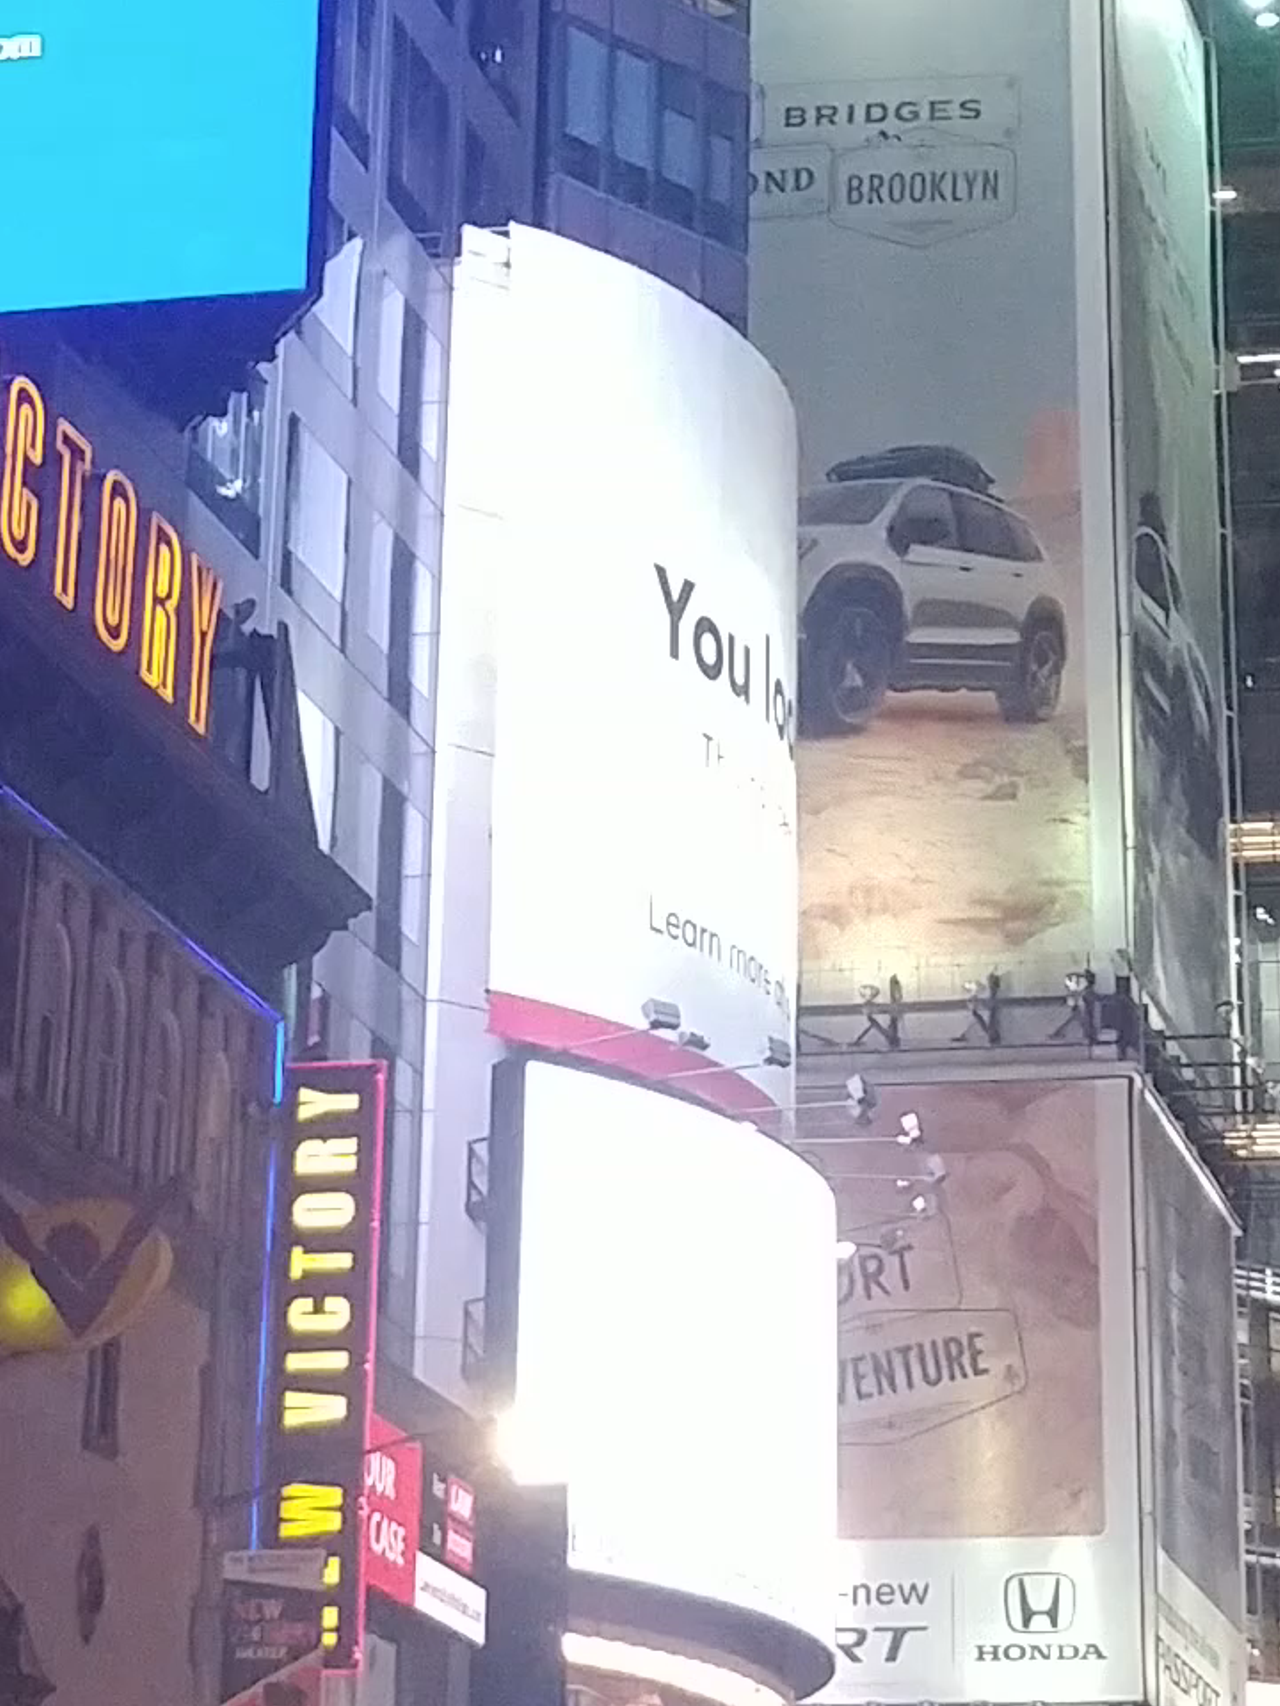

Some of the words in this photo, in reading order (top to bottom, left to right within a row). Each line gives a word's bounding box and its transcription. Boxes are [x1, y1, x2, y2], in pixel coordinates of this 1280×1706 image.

[783, 98, 983, 129] BRIDGES
[845, 168, 1001, 207] BROOKLYN
[652, 561, 751, 706] You
[648, 893, 721, 962] Learn
[281, 1085, 361, 1433] VICTORY
[370, 1510, 407, 1567] CASE
[974, 1641, 1109, 1664] HONDA
